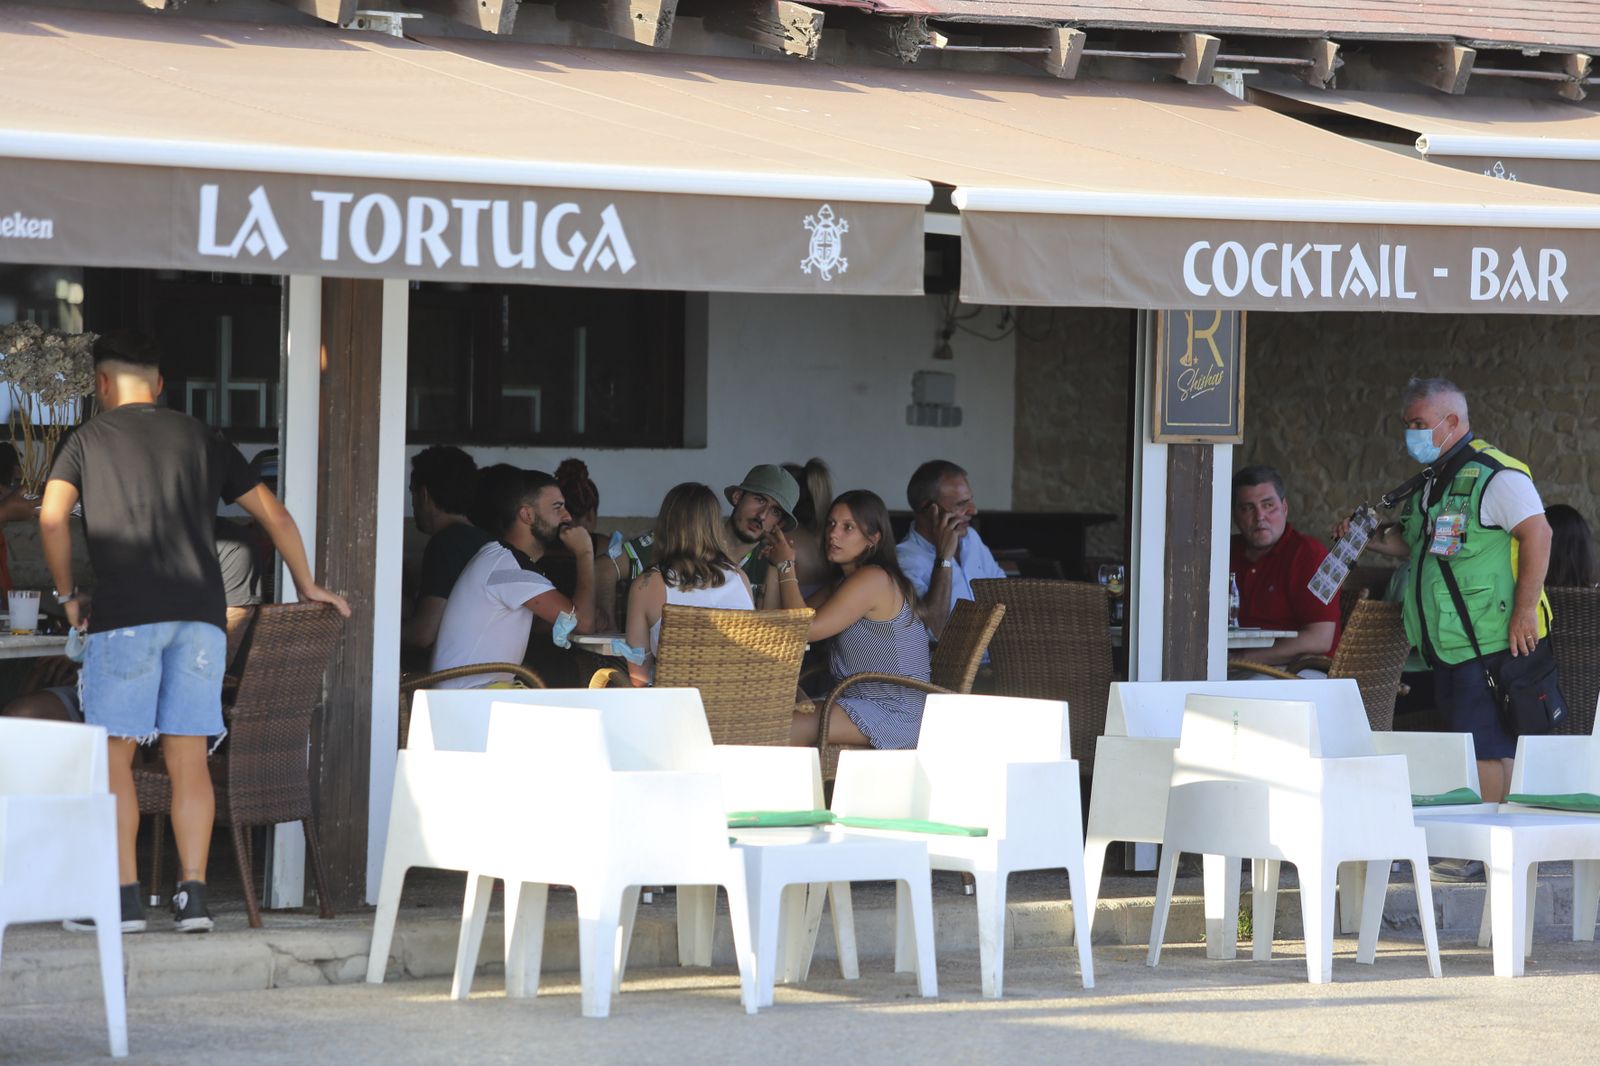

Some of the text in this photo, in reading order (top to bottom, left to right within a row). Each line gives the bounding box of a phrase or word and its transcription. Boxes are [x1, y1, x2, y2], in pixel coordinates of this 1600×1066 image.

[0, 211, 54, 239] eken
[197, 184, 636, 274] LA TORTUGA
[1182, 240, 1417, 299] COCKTAIL
[1470, 246, 1569, 303] BAR
